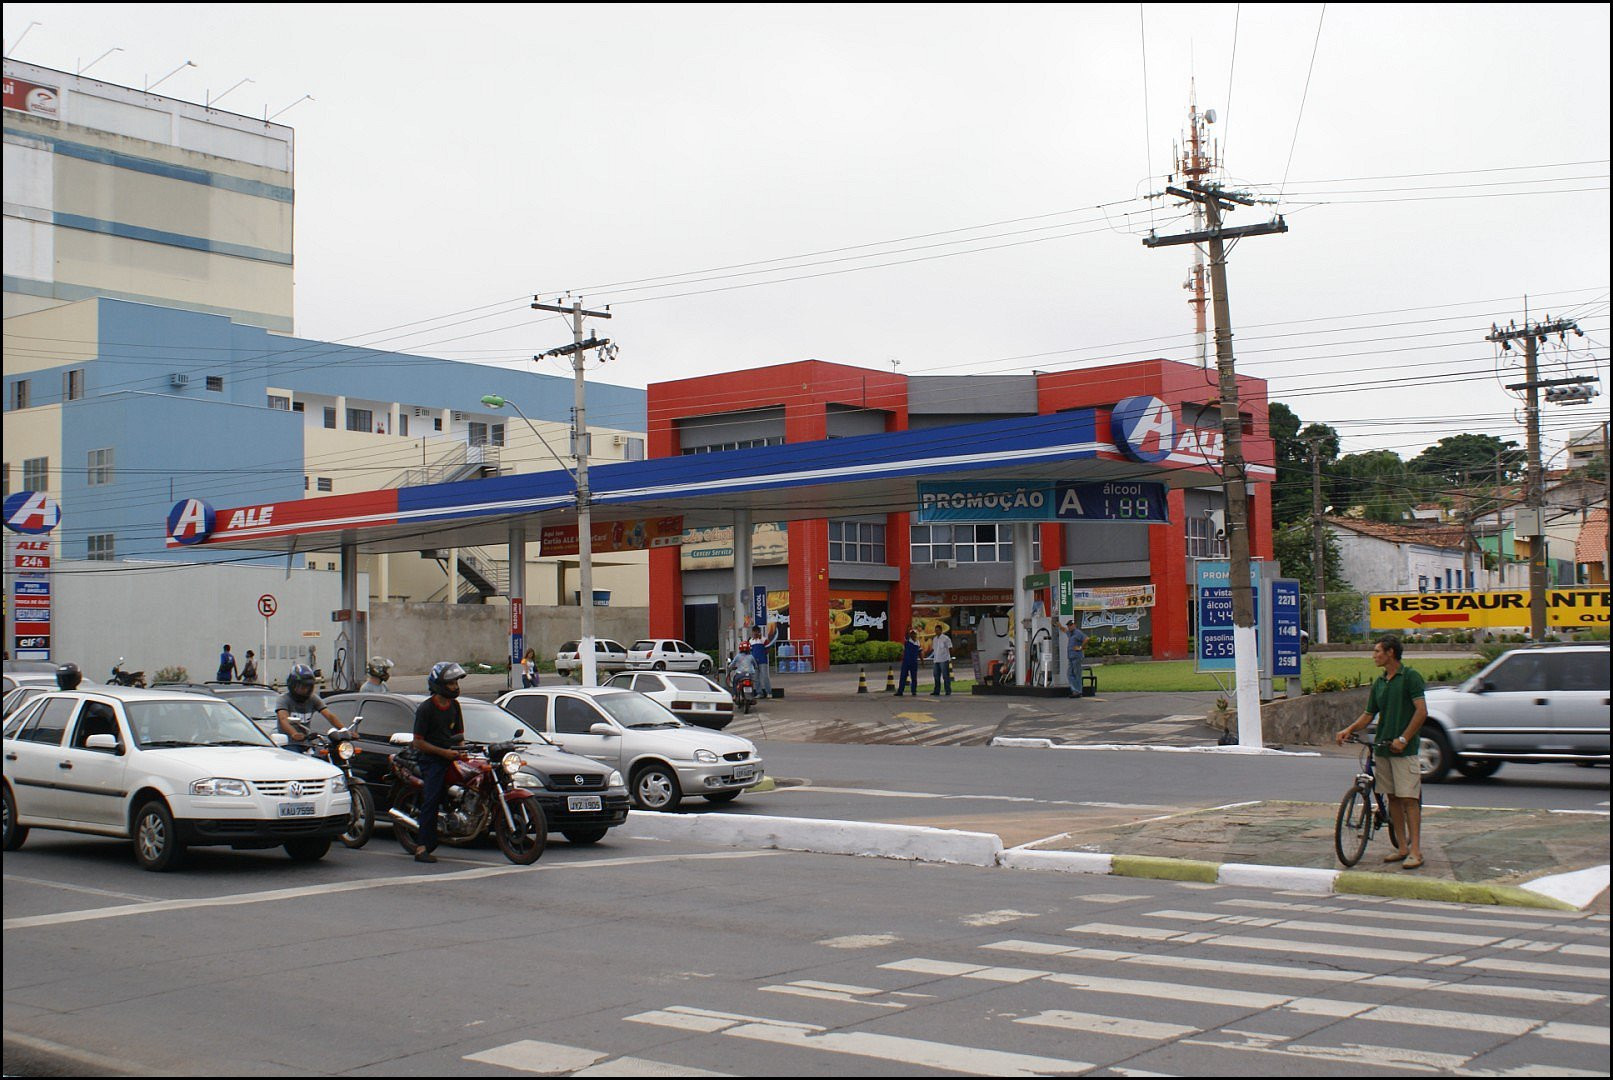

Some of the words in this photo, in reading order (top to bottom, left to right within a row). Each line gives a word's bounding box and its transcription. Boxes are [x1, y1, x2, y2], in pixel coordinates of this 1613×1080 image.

[1103, 482, 1141, 495] álcool
[922, 487, 1044, 511] PROMOÇÃO
[1058, 488, 1084, 515] A
[227, 506, 274, 529] ALE
[16, 541, 50, 551] ALE
[21, 556, 43, 567] 24h
[1213, 589, 1233, 597] vista
[1207, 600, 1232, 609] álcool
[20, 638, 36, 647] elf
[1204, 633, 1234, 643] gasolina
